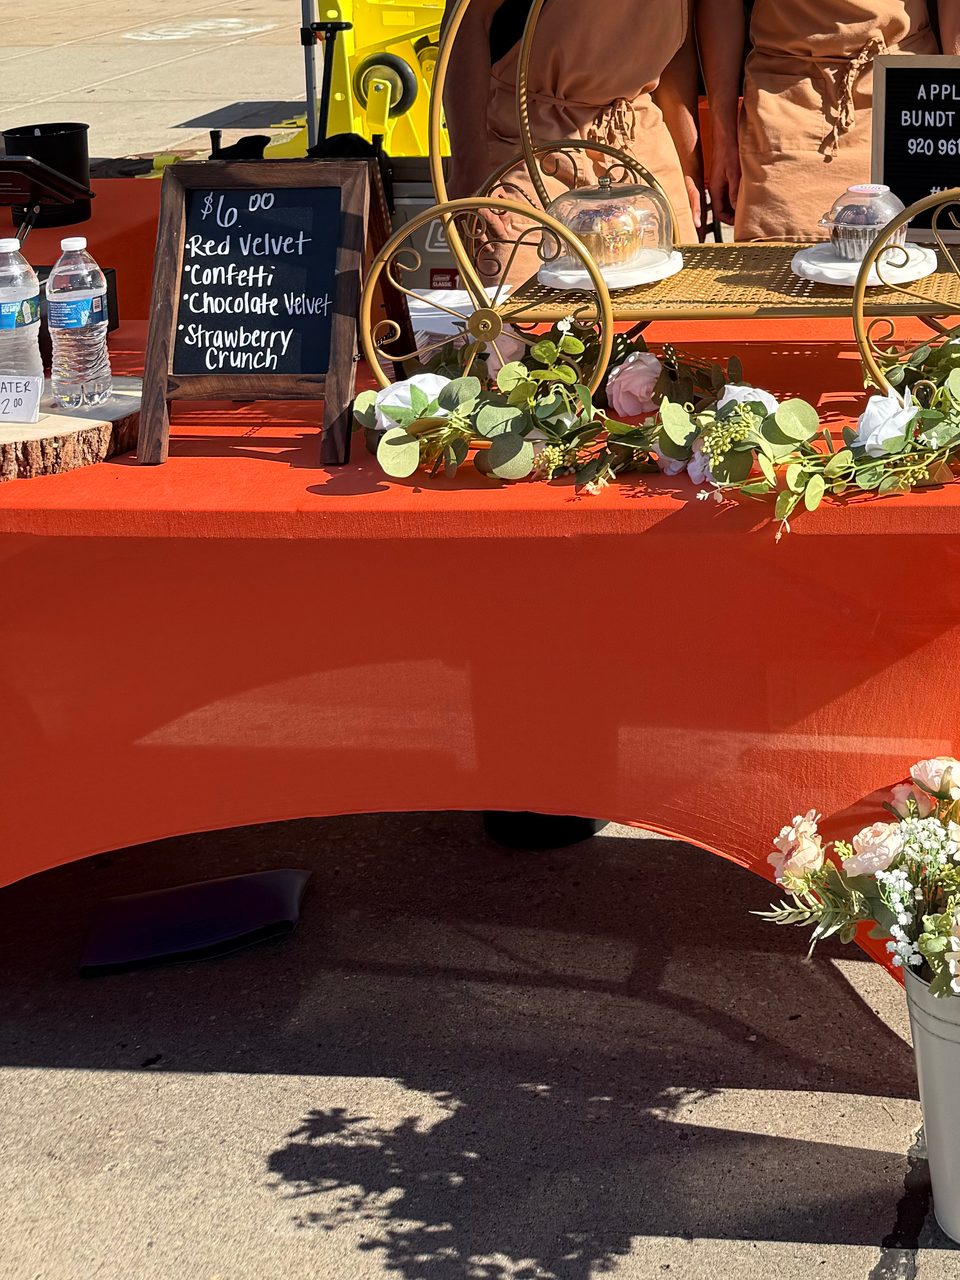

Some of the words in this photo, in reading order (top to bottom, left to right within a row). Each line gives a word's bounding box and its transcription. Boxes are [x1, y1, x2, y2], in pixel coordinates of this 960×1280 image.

[901, 110, 956, 128] BUNDT
[907, 138, 934, 156] 920
[190, 234, 231, 258] Red
[190, 264, 275, 288] Confetti
[188, 292, 279, 316] Chocolate
[284, 293, 333, 317] Velvet
[184, 324, 294, 356] Strawberry
[205, 347, 278, 371] Crunch
[0, 380, 32, 394] ATER
